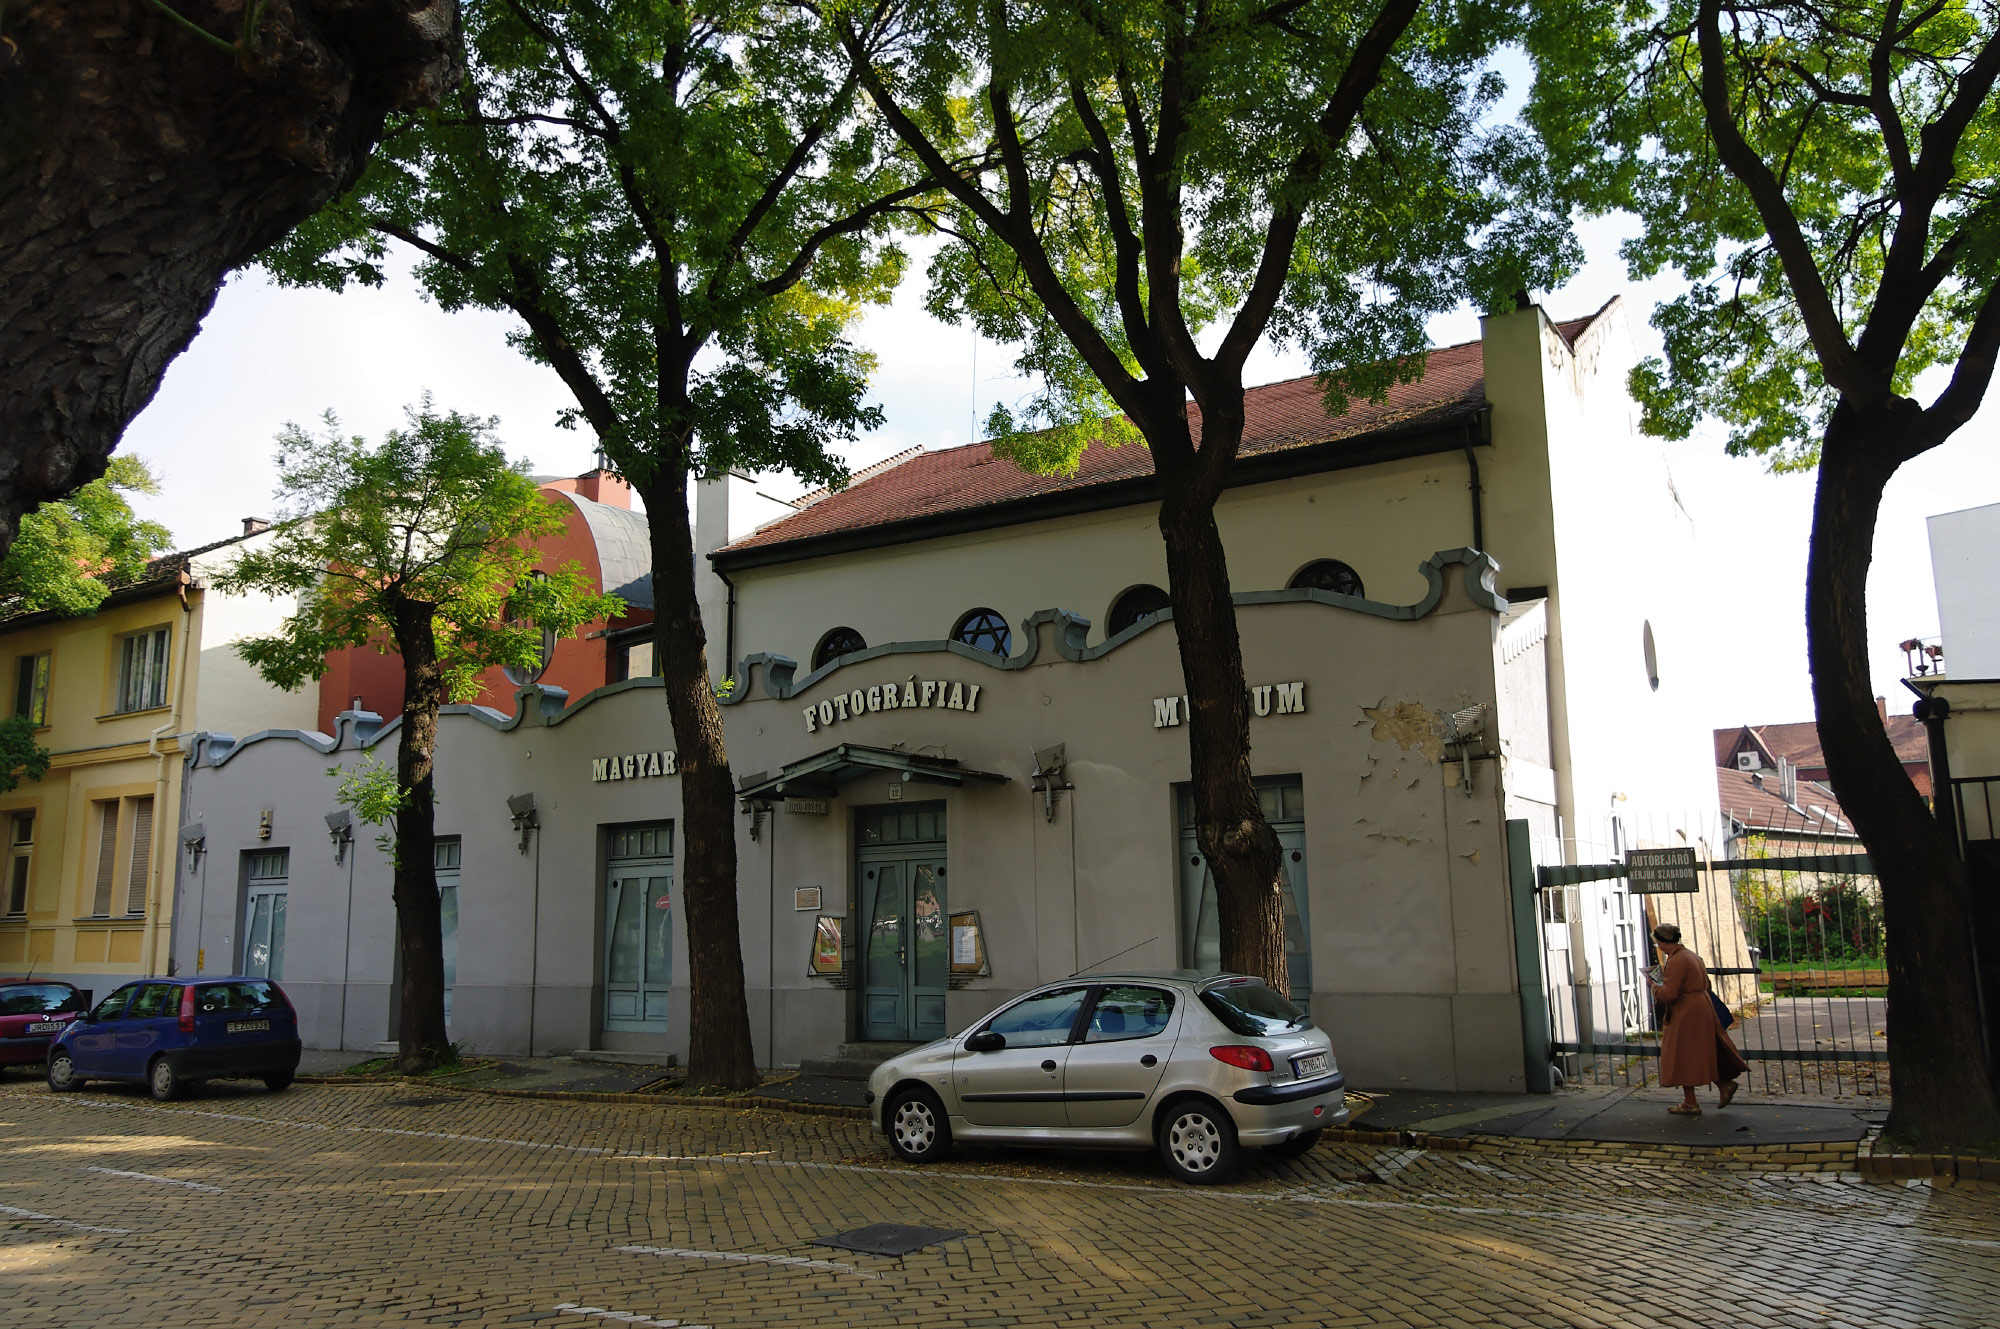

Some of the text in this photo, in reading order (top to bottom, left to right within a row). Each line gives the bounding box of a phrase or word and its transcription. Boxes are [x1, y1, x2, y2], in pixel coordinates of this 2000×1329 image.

[803, 674, 980, 733] FOTOGRÁFIAI
[1153, 681, 1305, 728] MUM
[592, 750, 676, 782] MAGYAR
[1631, 850, 1690, 867] AUTÓBEJÁRÓ
[1657, 867, 1694, 879] SZABADON
